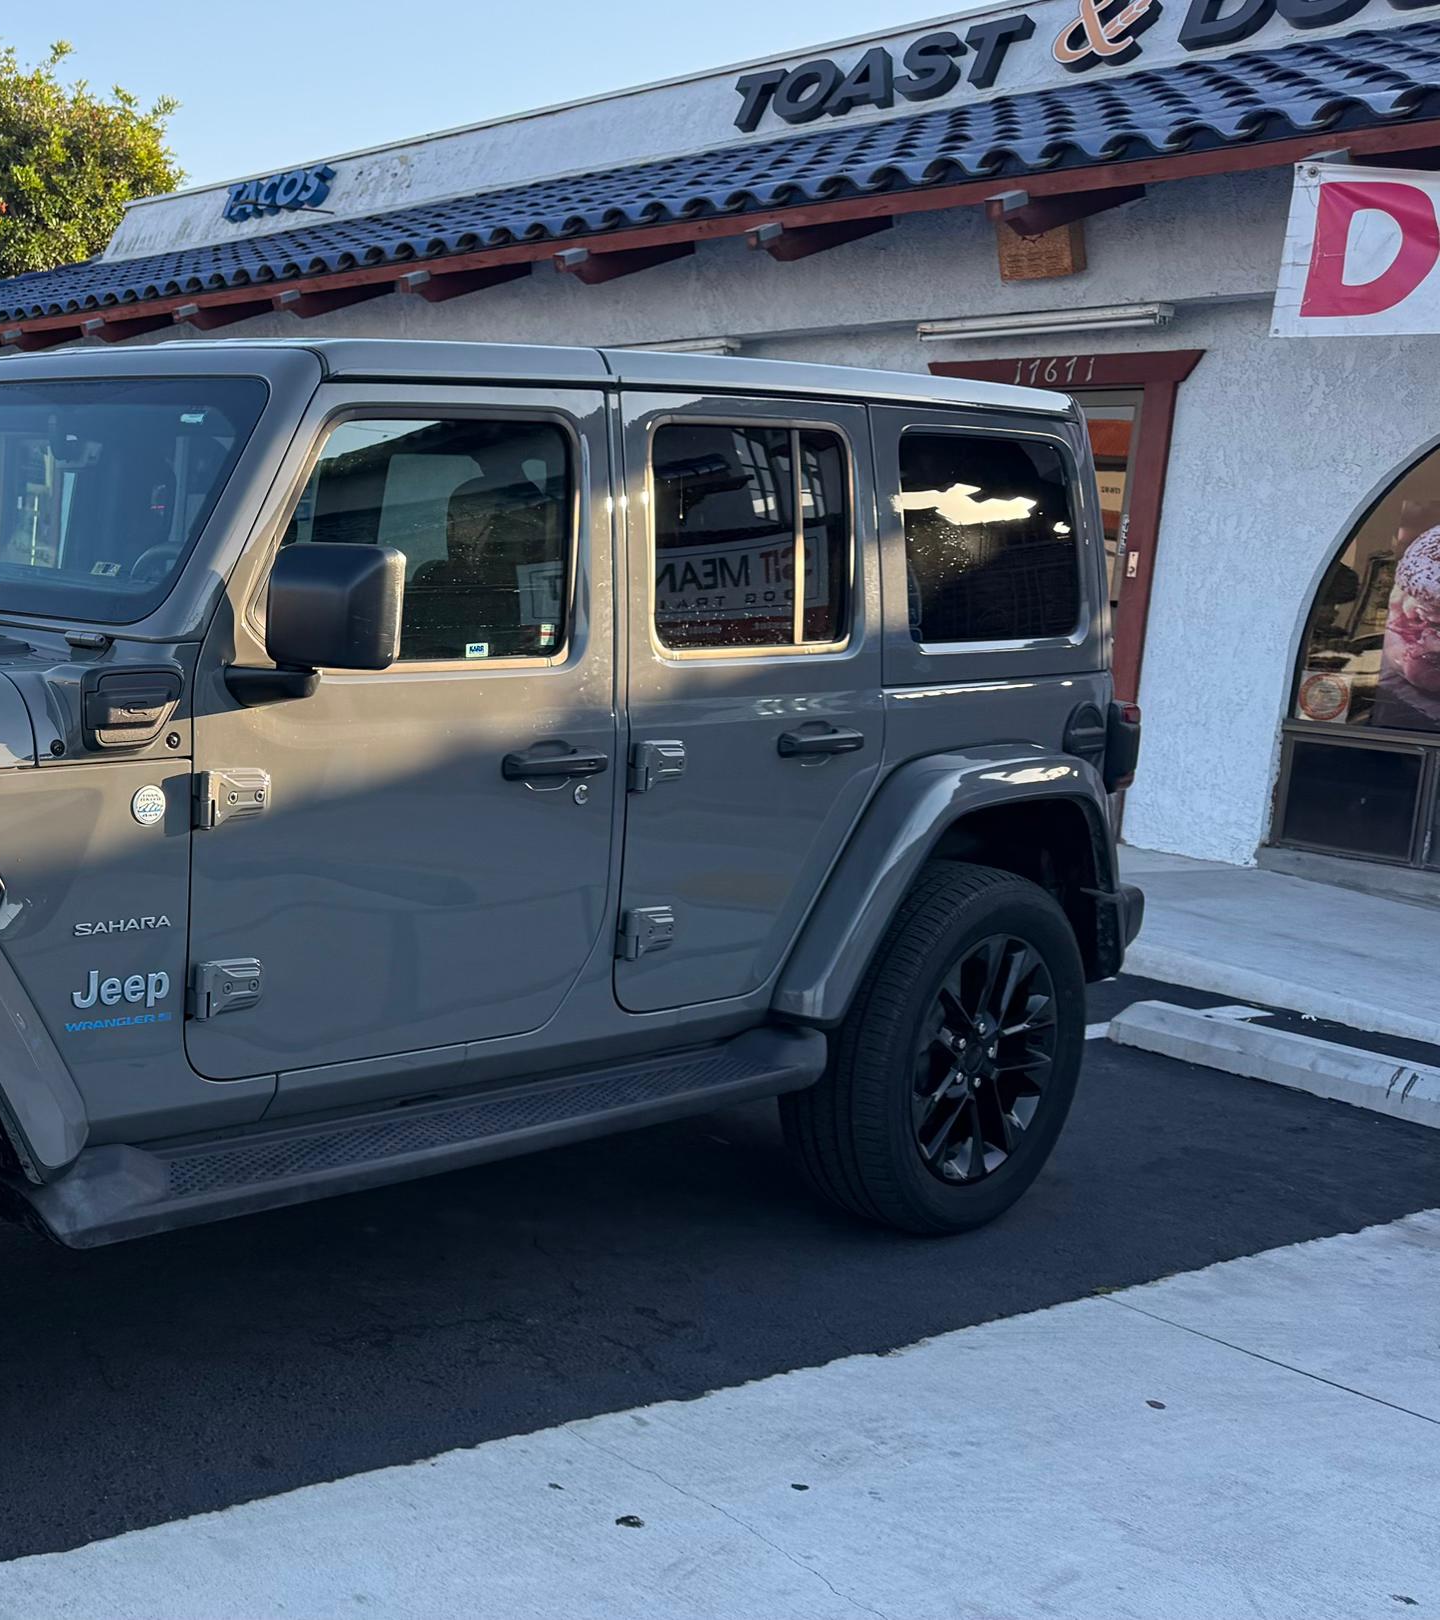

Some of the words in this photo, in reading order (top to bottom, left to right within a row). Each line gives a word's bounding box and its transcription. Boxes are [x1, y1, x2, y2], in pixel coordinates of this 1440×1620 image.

[733, 14, 1036, 133] TOAST
[223, 163, 332, 220] TACOS
[73, 915, 172, 937] SAHARA
[71, 969, 170, 1009] Jeep
[64, 1013, 156, 1032] WRANGLER
